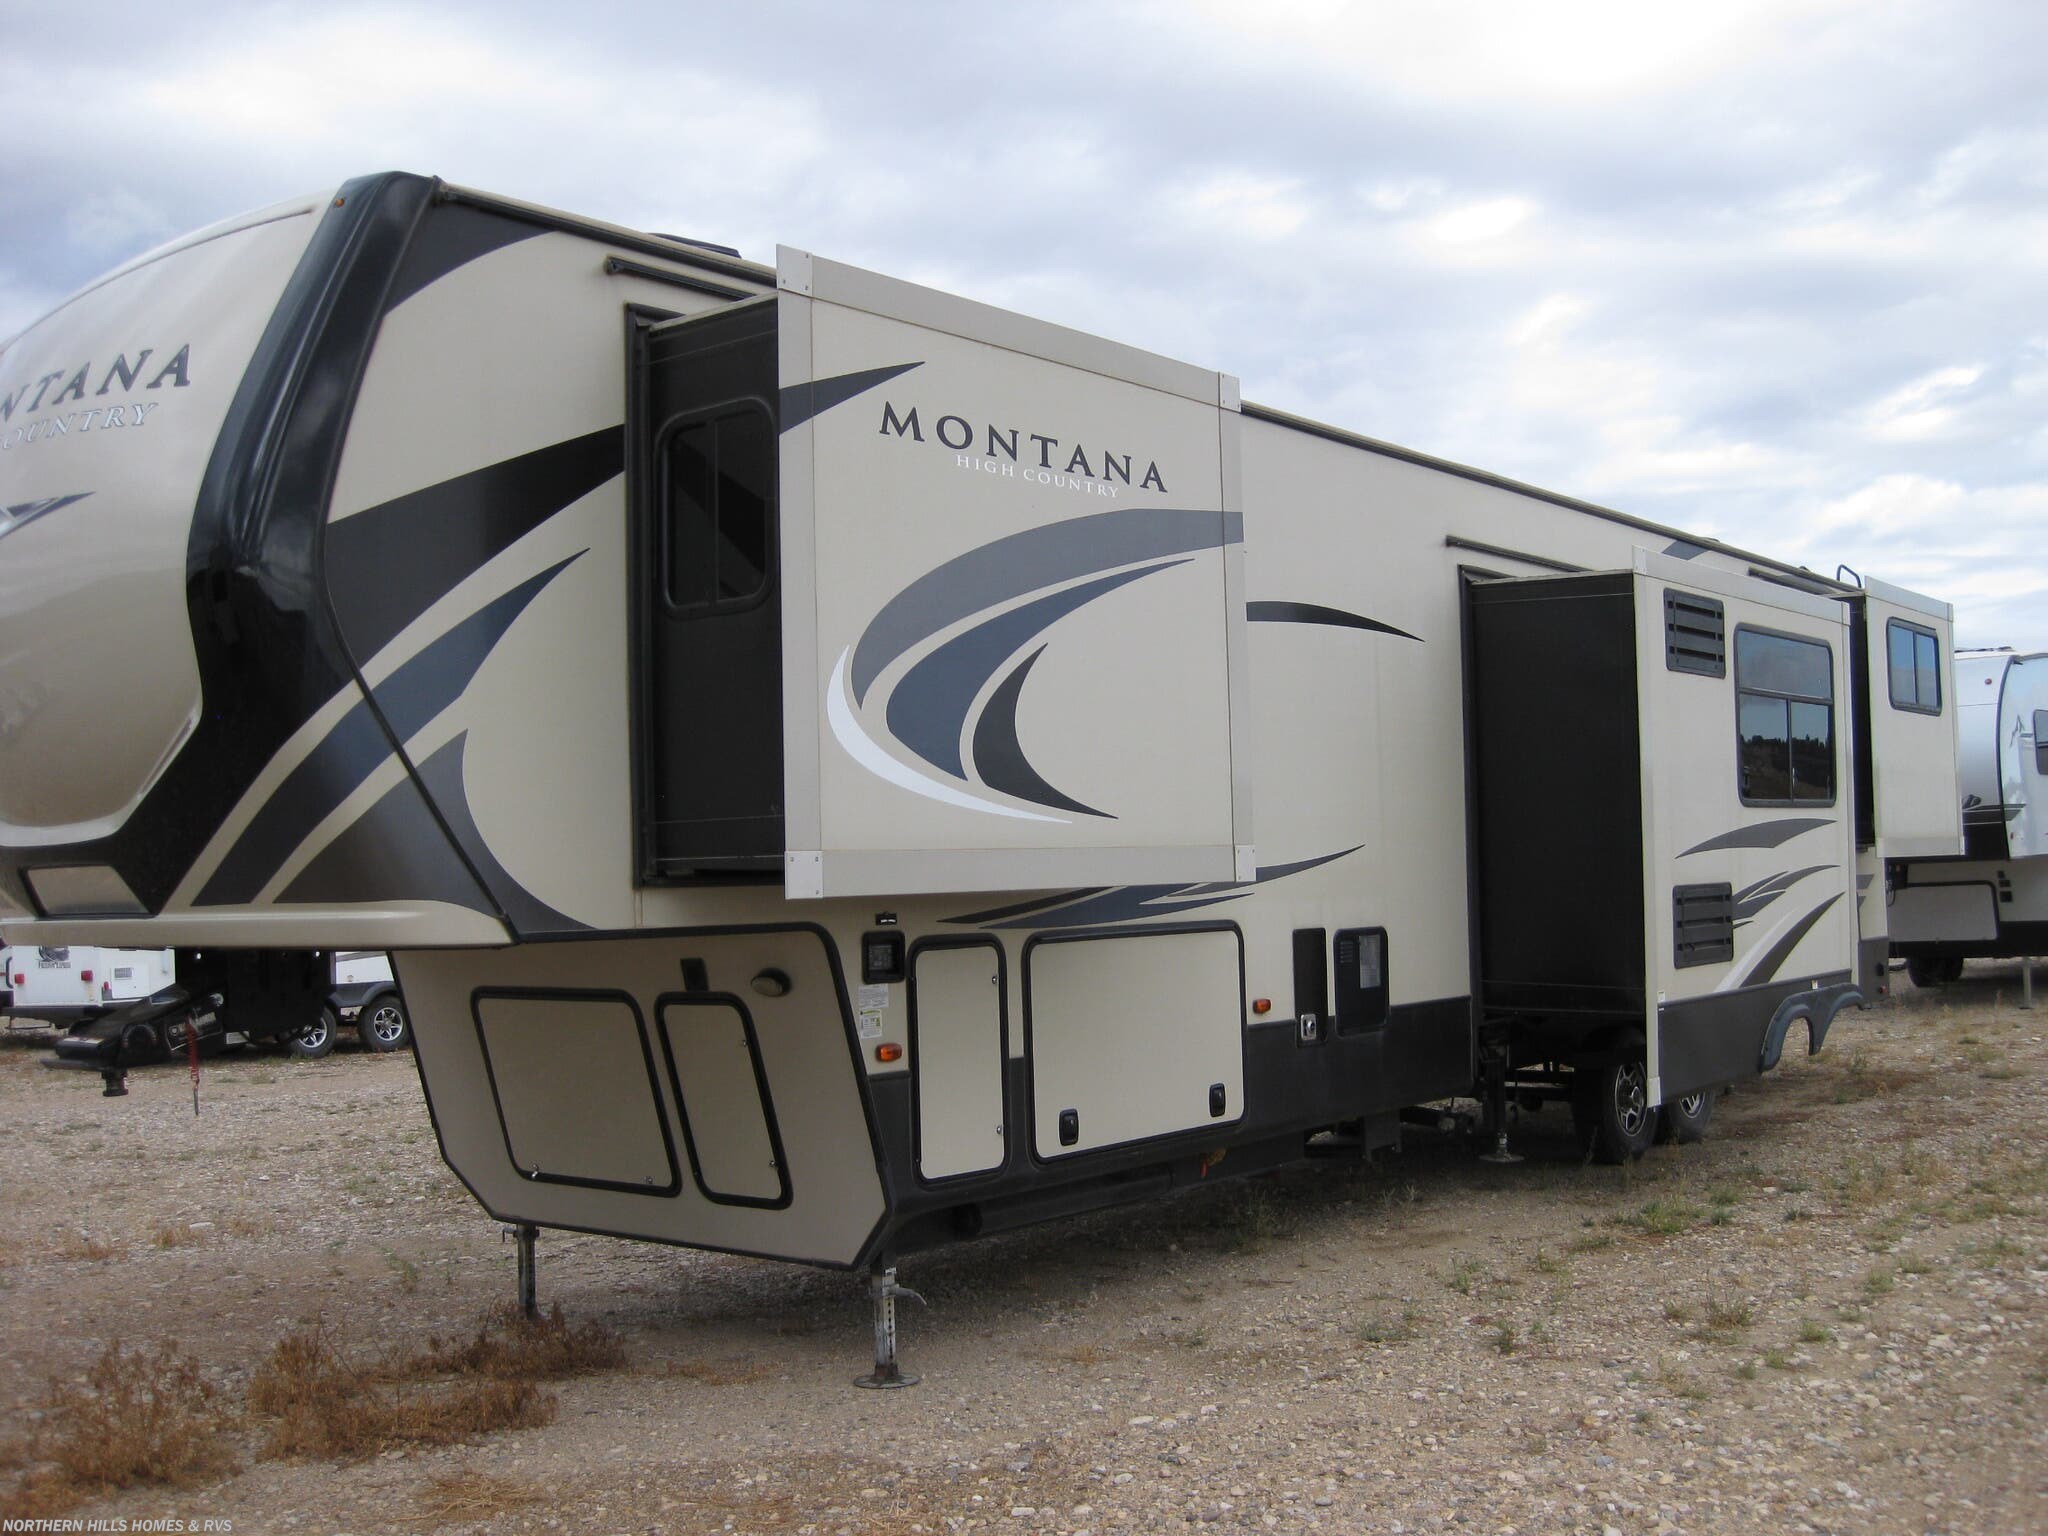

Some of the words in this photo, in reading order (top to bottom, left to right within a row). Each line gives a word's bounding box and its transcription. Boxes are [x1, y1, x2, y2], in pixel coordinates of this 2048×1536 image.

[879, 401, 1168, 493] MONTANA
[956, 454, 1015, 478] HIGH
[1023, 468, 1120, 498] COUNTRY
